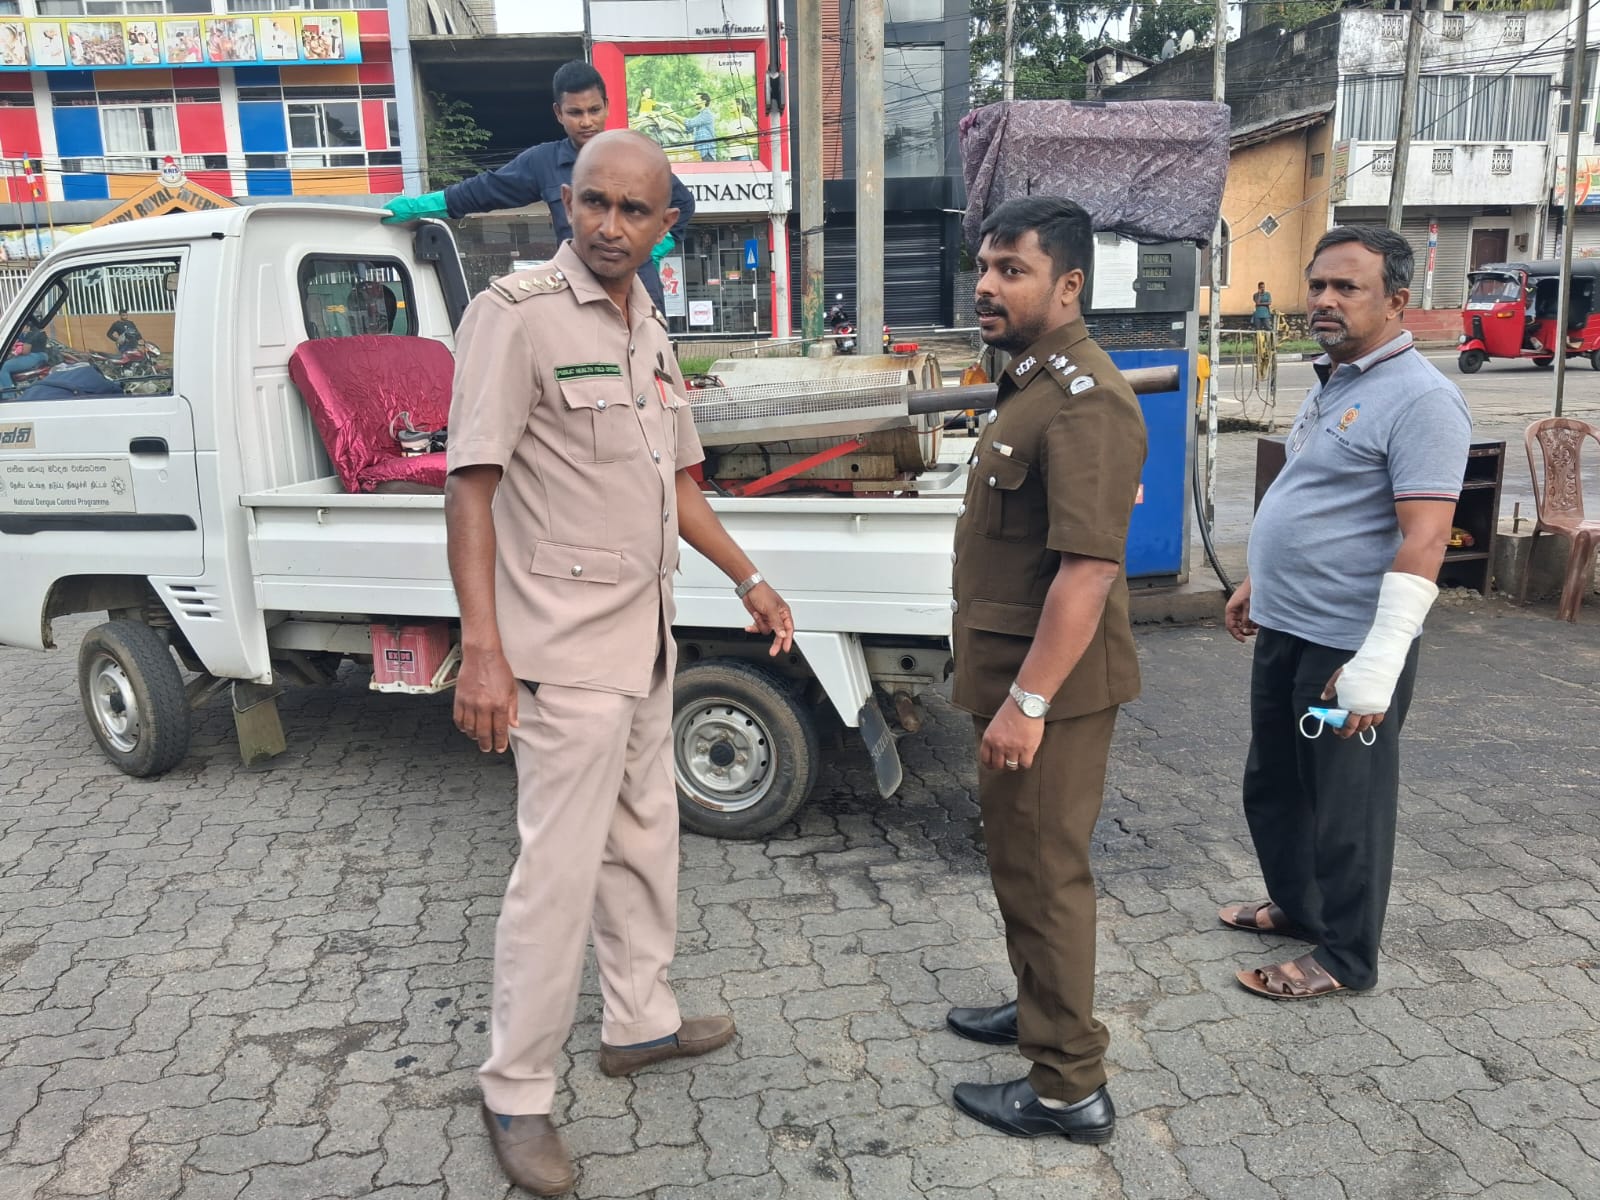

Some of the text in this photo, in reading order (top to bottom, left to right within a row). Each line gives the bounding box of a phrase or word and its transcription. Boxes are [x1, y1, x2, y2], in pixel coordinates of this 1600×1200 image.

[696, 23, 767, 35] www.lbfinance.l
[134, 188, 174, 217] ROYAL
[13, 498, 110, 507] National Dengue Control Programme
[387, 652, 411, 661] EXDE
